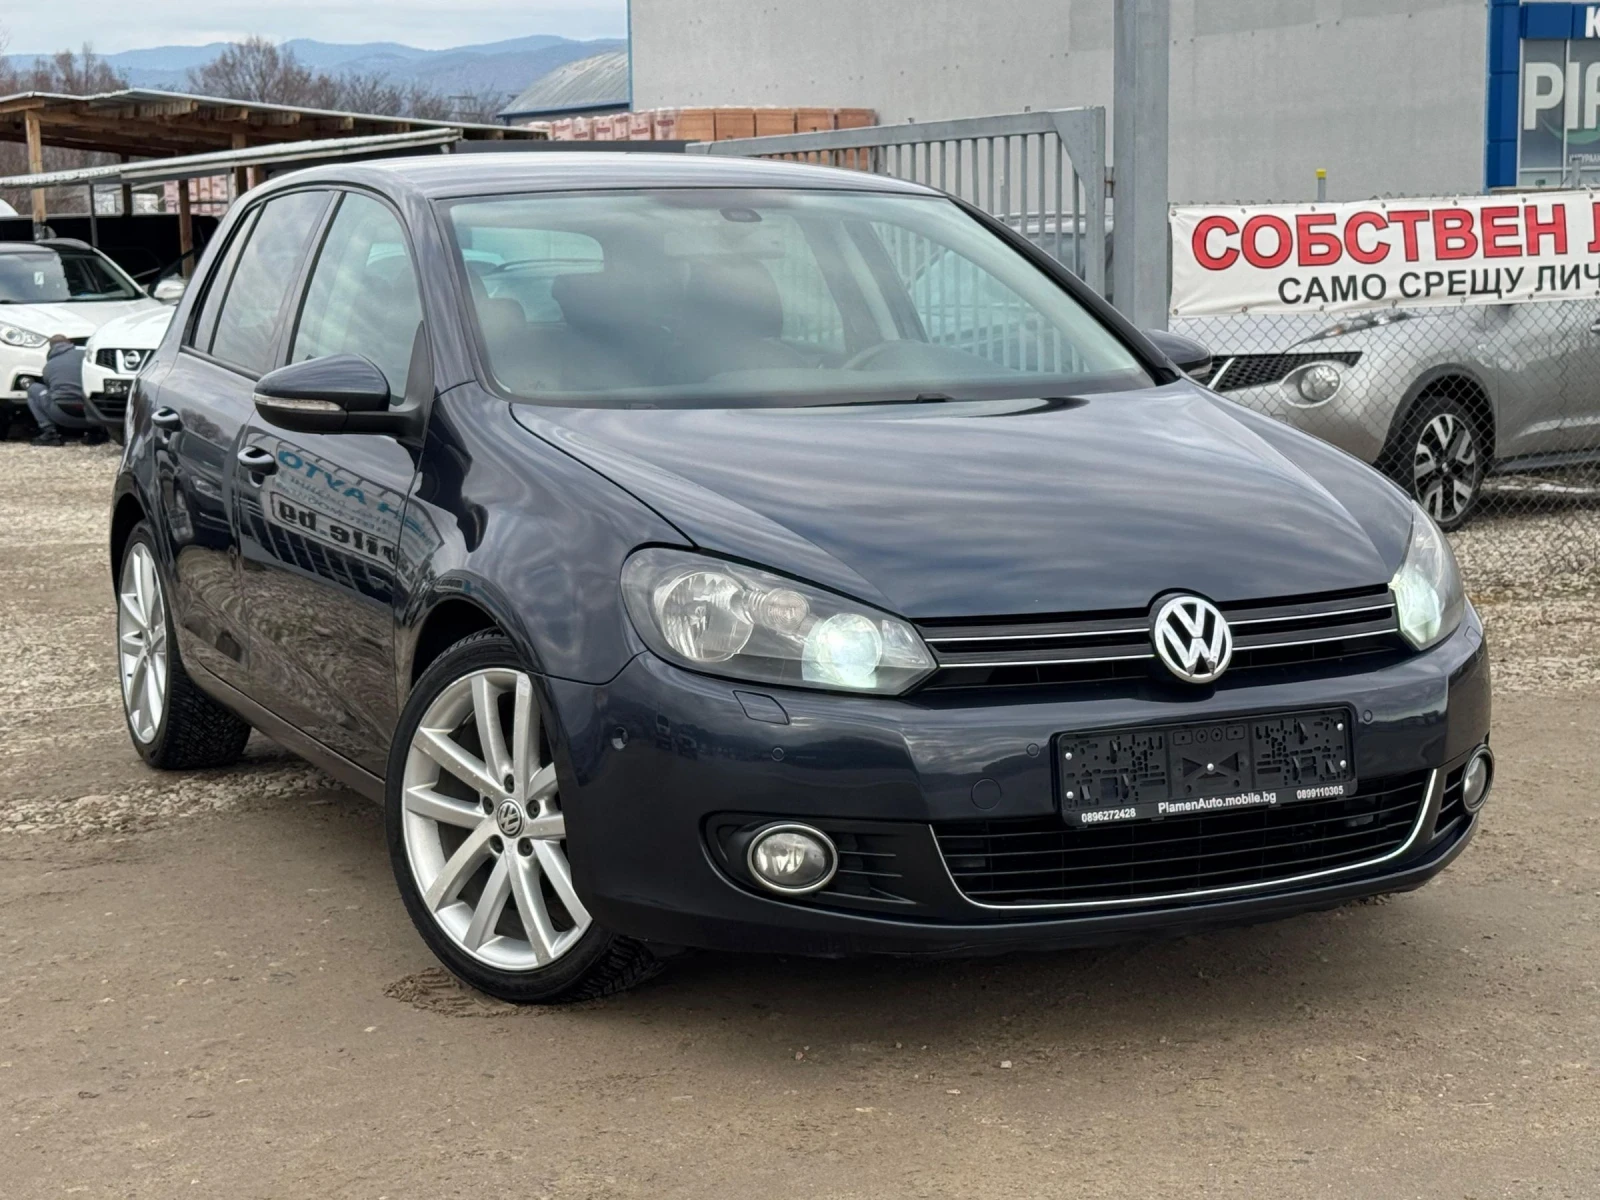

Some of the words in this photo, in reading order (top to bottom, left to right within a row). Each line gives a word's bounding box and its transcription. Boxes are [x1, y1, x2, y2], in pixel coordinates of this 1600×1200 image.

[1192, 203, 1568, 271] СОБСТВЕН
[1278, 273, 1387, 304] САМО
[1399, 266, 1524, 299] СРЕЩУ
[1081, 807, 1136, 823] 0896272428
[1158, 791, 1277, 814] PlamenAuto.mobile.bg
[1296, 785, 1344, 800] 0899110305
